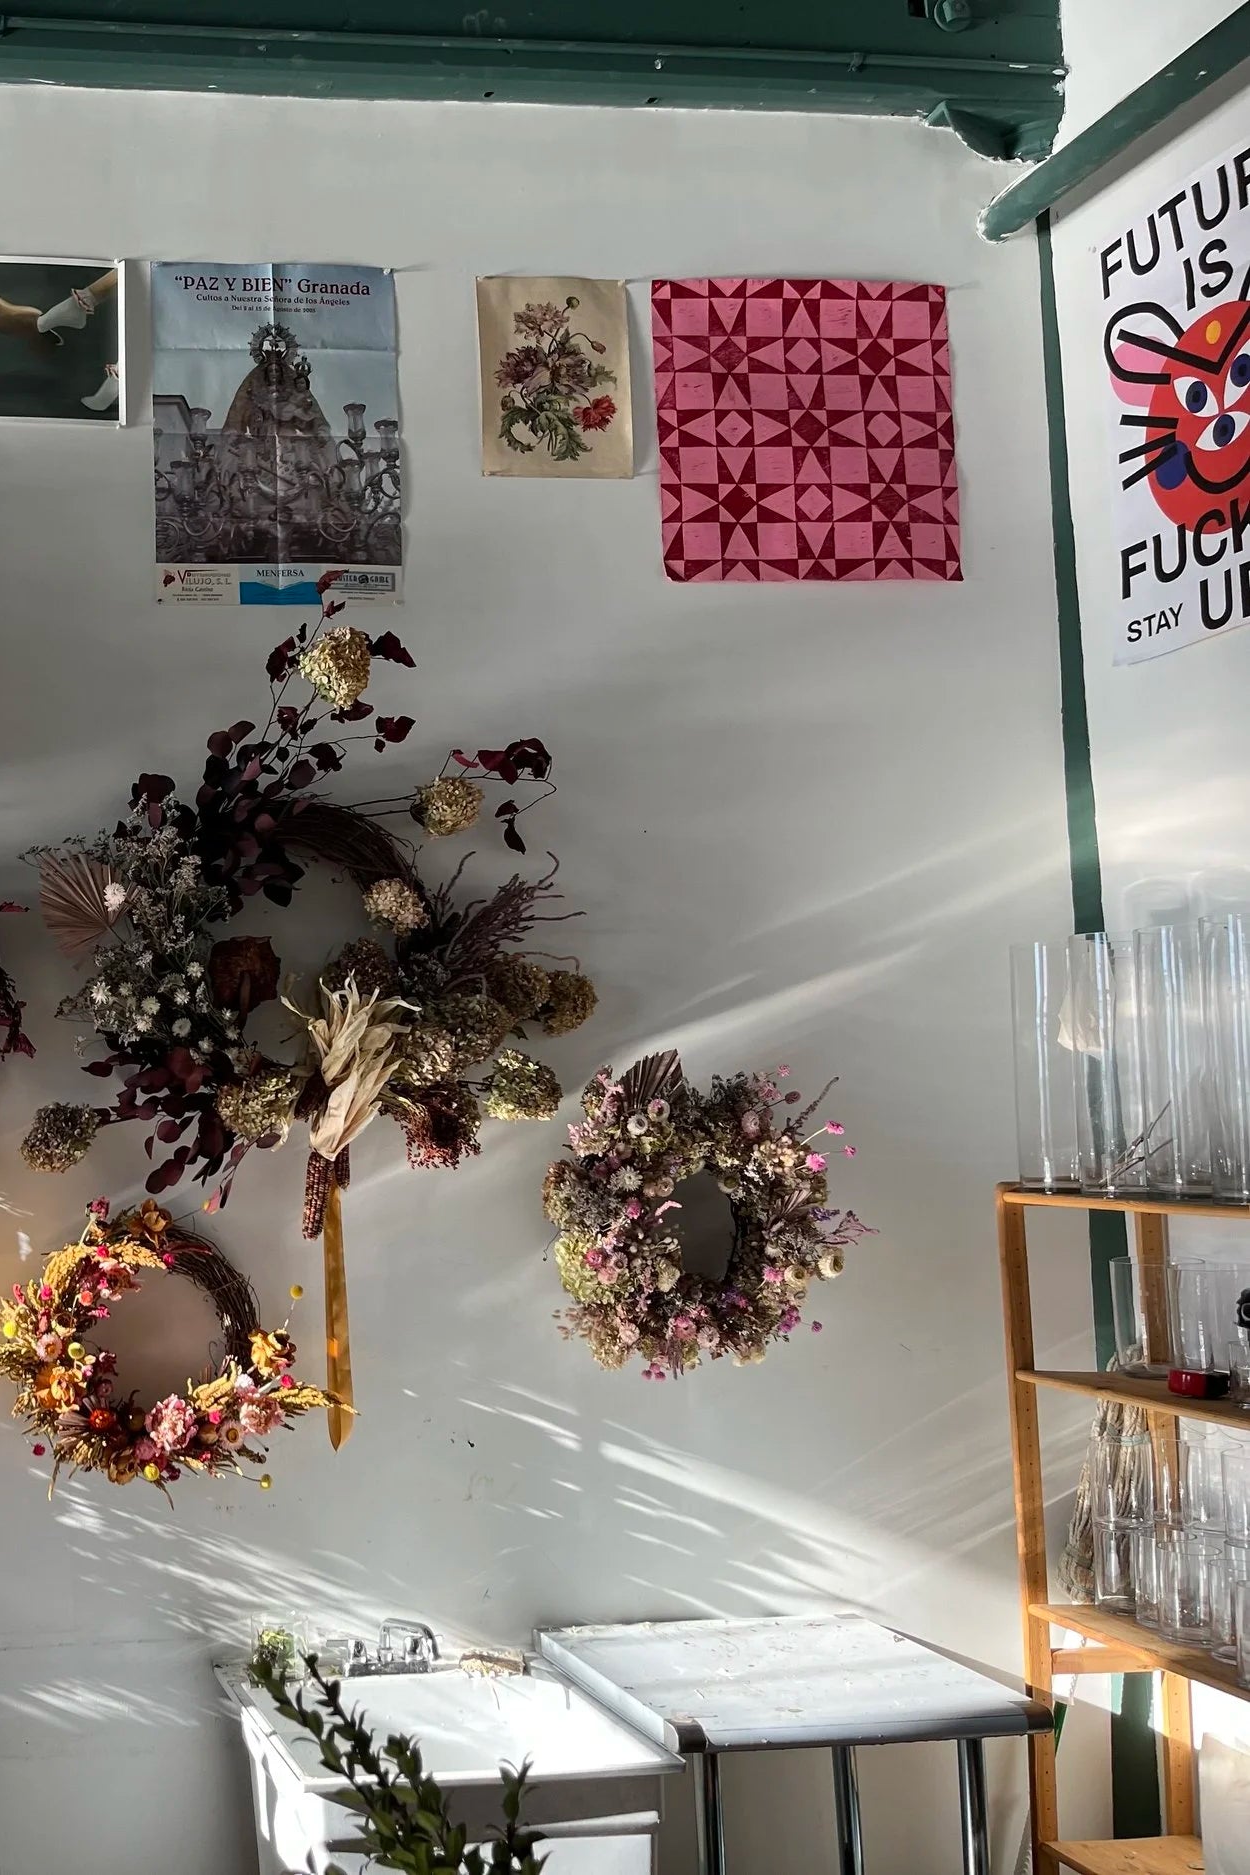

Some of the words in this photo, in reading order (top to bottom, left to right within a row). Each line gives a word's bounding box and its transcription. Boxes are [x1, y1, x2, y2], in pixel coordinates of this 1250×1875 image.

[224, 277, 237, 291] Y
[297, 279, 371, 296] Granada
[1182, 238, 1234, 312] IS
[196, 293, 223, 302] Cultos
[231, 295, 262, 303] Nuestra
[264, 295, 292, 303] Señora
[293, 296, 304, 304] de
[305, 297, 318, 305] los
[1120, 498, 1250, 600] FUCK
[1126, 602, 1184, 643] STAY
